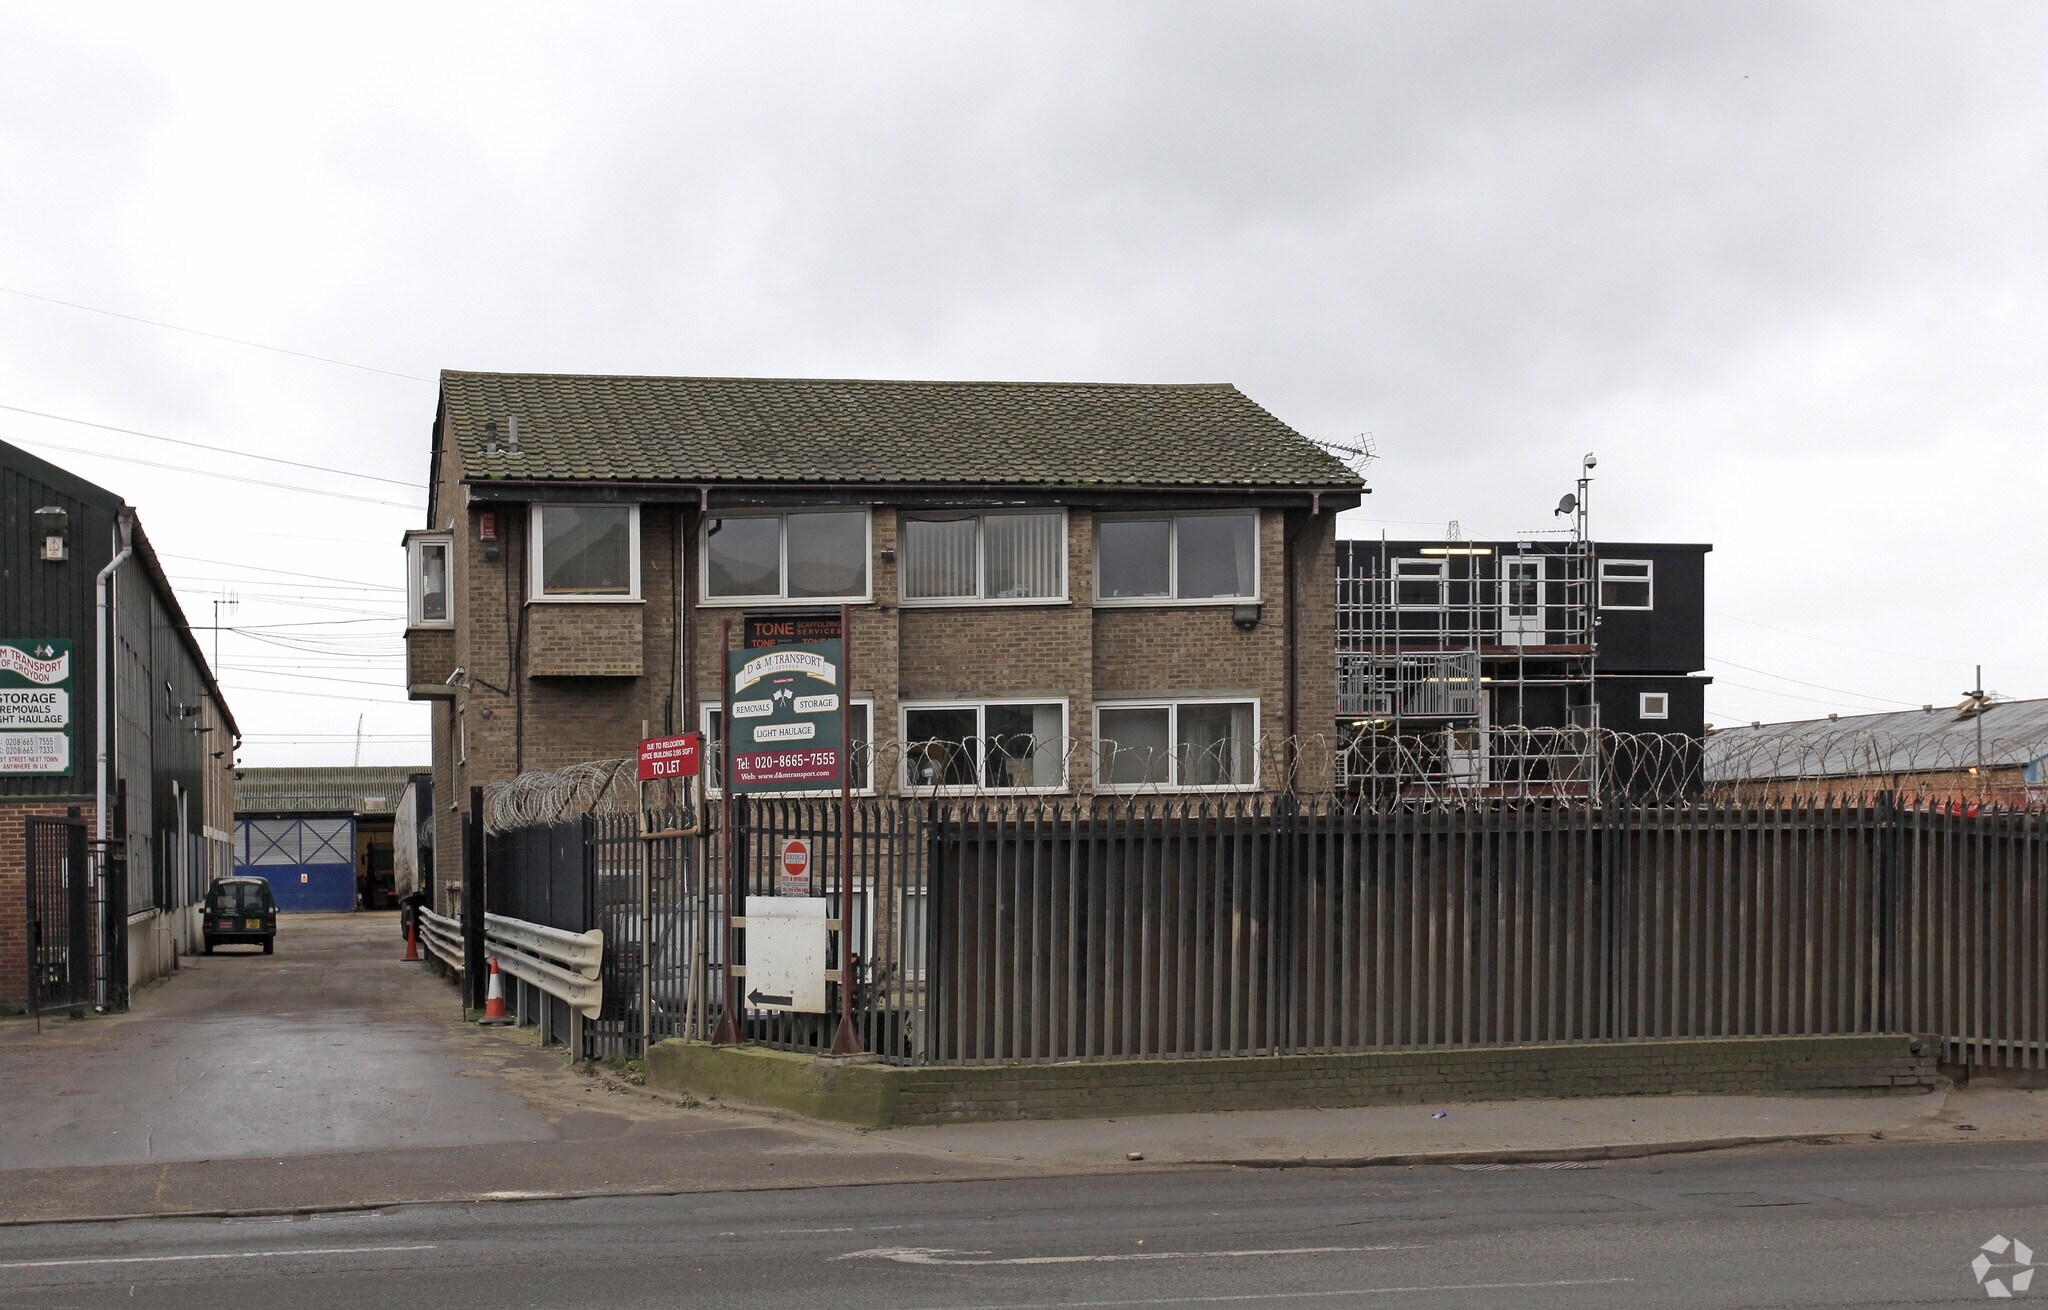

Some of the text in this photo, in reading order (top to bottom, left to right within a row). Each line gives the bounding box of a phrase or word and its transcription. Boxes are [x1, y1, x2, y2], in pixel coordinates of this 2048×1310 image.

[754, 622, 794, 636] TONE
[752, 639, 776, 648] TONE
[11, 650, 62, 672] TRANSPORT
[747, 653, 821, 674] D & M TRANSPORT
[14, 661, 50, 681] CROYDON
[736, 703, 770, 714] REMOVALS
[800, 699, 833, 708] STORAGE
[0, 705, 51, 714] REMOVALS
[19, 715, 63, 723] HAULAGE
[757, 726, 812, 738] LIGHT HAULAGE
[6, 738, 21, 746] 0208
[23, 738, 34, 746] 665
[39, 737, 54, 746] 7555
[662, 740, 685, 748] RELOCATION
[6, 746, 21, 754] 0208
[23, 746, 34, 754] 665
[39, 746, 54, 754] 7333
[736, 752, 835, 770] Tel: 020-8665-7555
[652, 760, 680, 775] TO LET
[758, 770, 830, 780] www.d&mtransport.com
